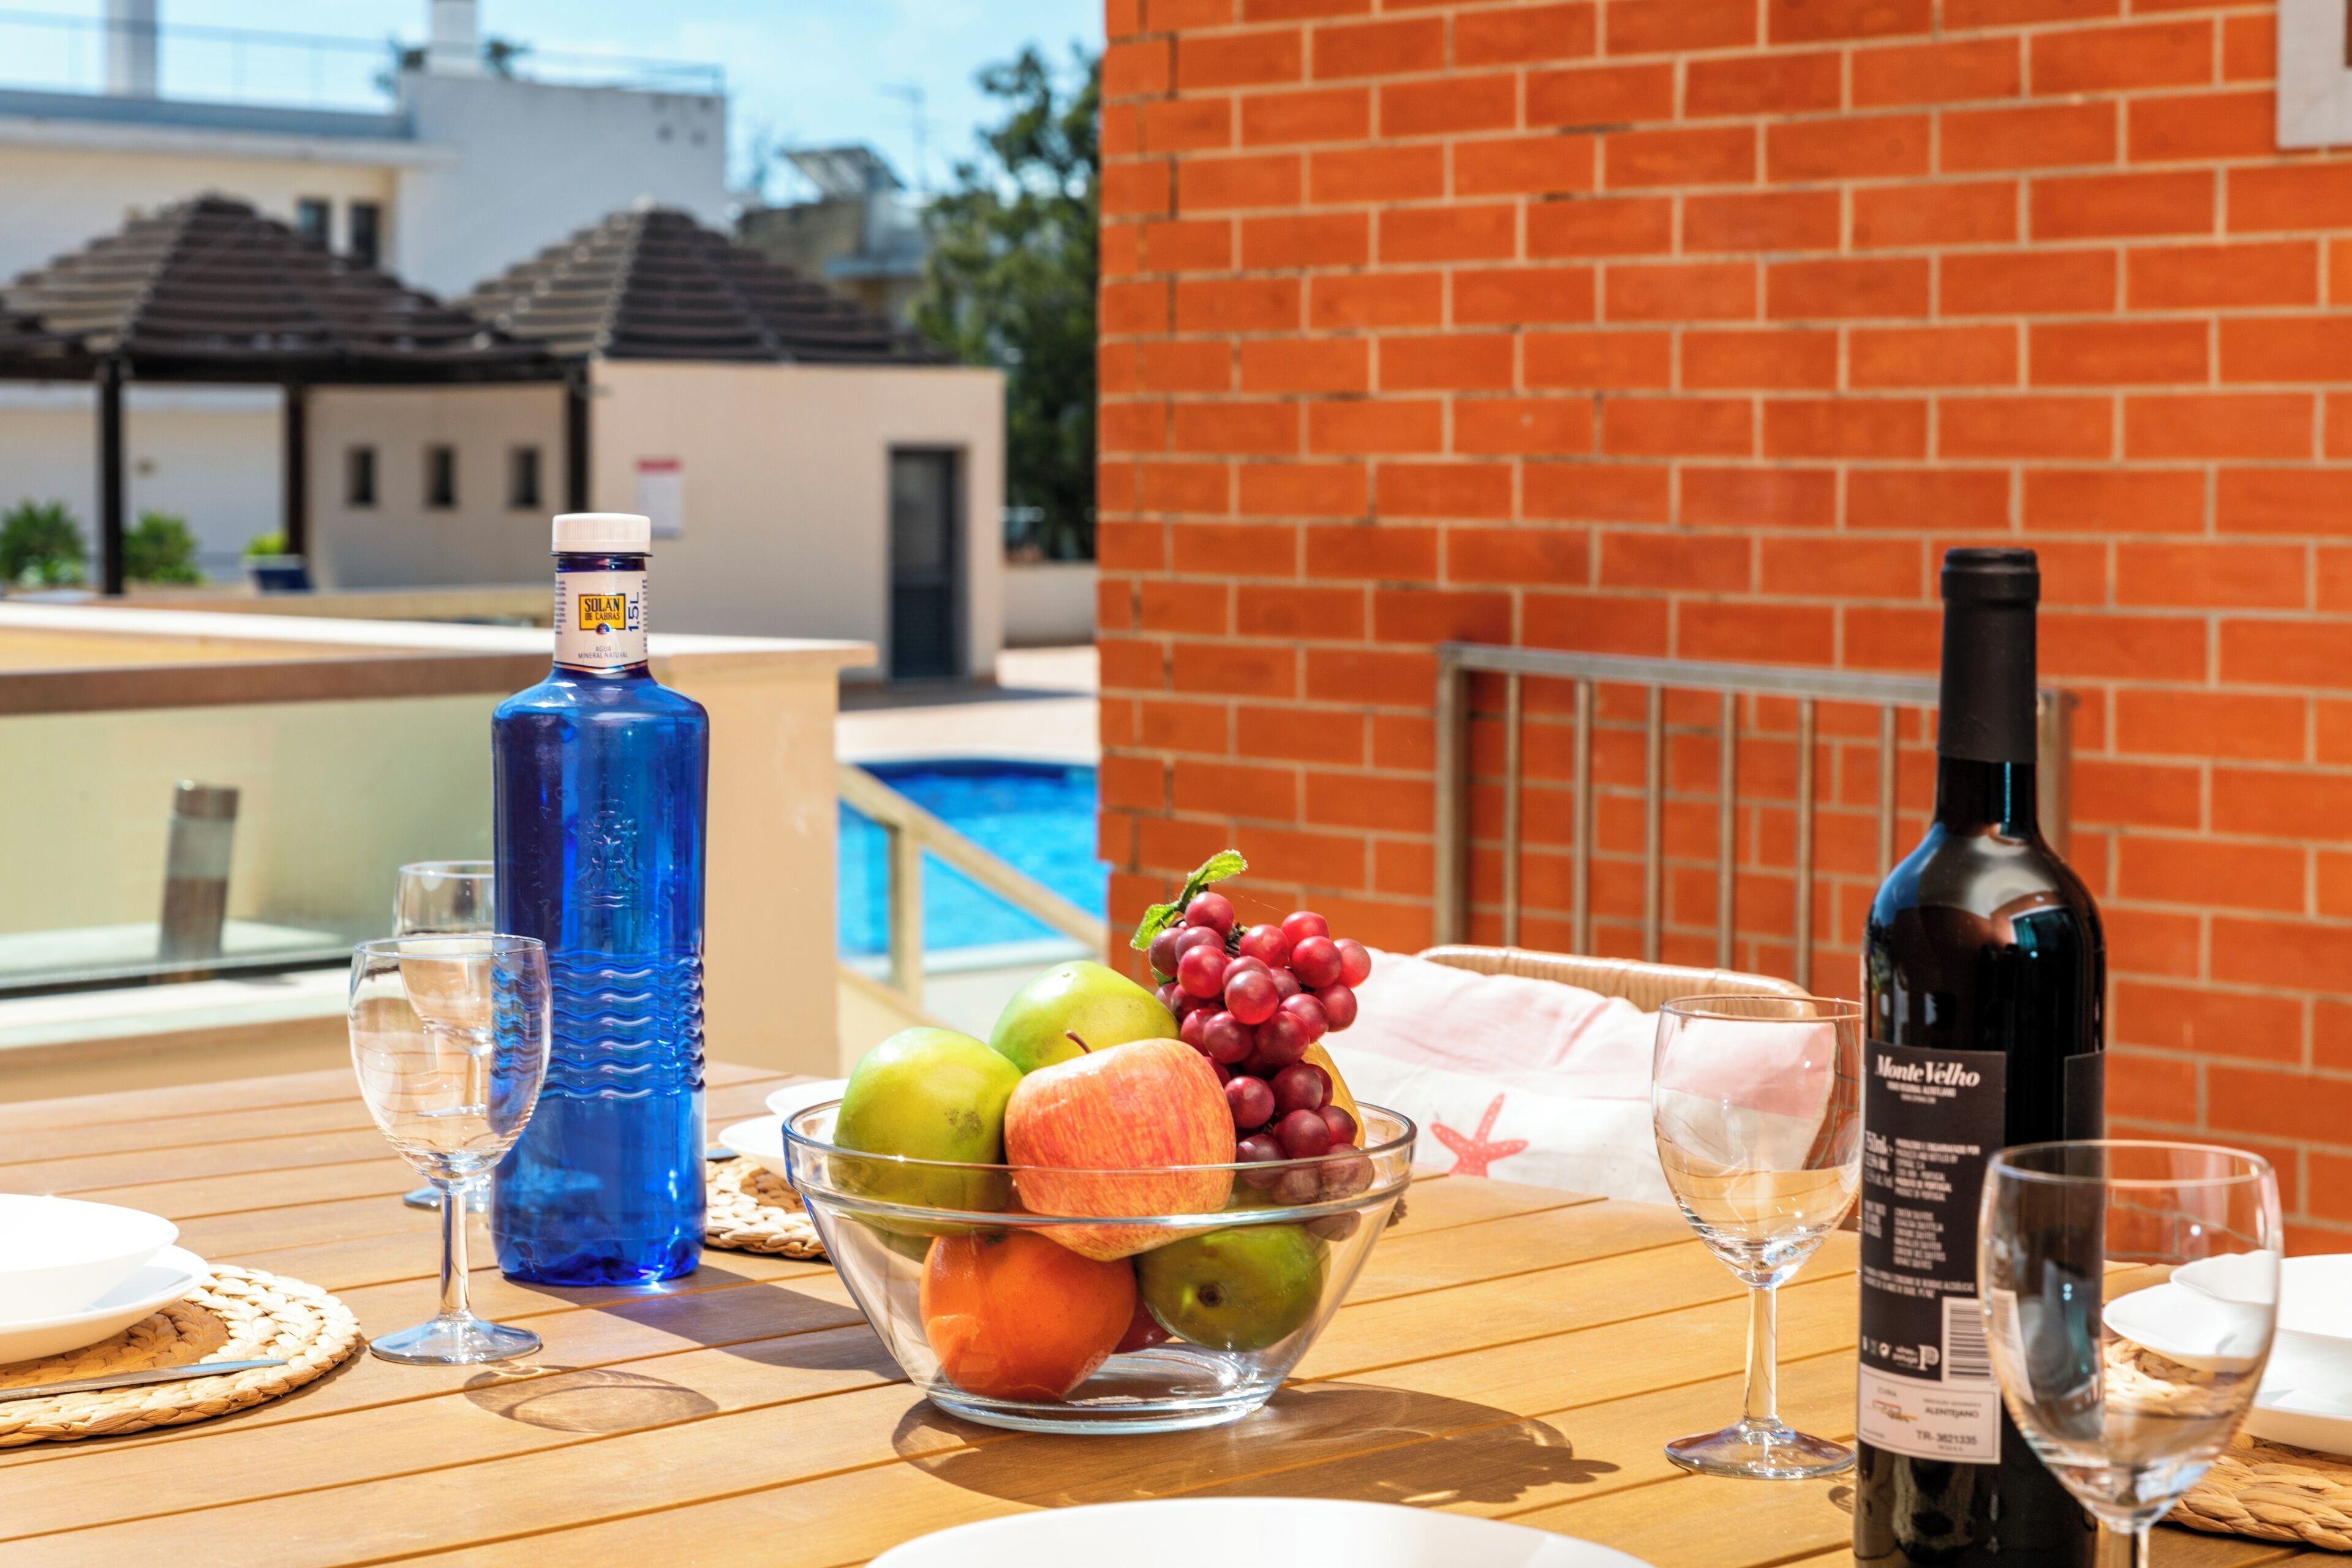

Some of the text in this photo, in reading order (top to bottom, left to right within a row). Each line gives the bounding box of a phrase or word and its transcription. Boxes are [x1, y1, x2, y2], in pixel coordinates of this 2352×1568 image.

[595, 612, 620, 620] CABRAS
[628, 592, 640, 631] 1,5L
[1875, 1054, 1980, 1087] Monte Velho
